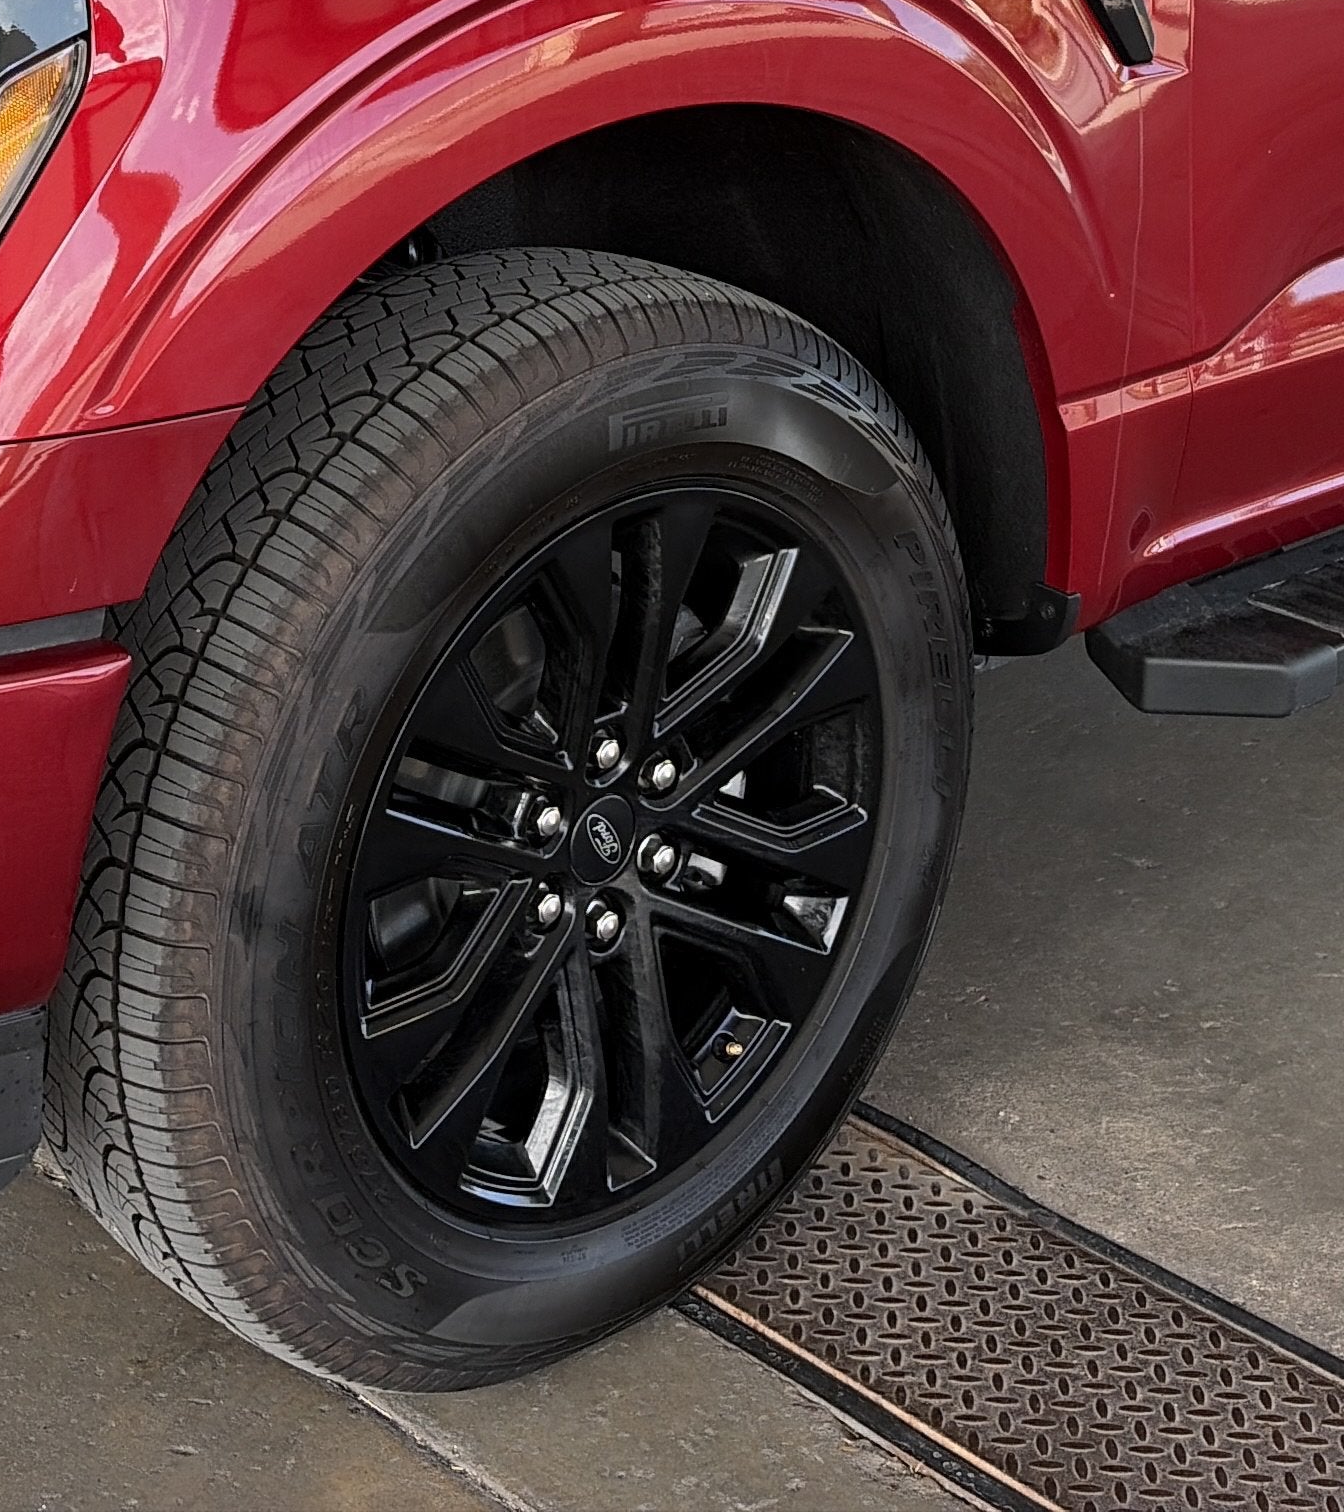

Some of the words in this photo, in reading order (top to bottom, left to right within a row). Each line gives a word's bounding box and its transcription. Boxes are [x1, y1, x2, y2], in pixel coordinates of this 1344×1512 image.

[892, 529, 955, 802] PIRELLI
[295, 686, 372, 889] ATR
[592, 821, 618, 857] Ford
